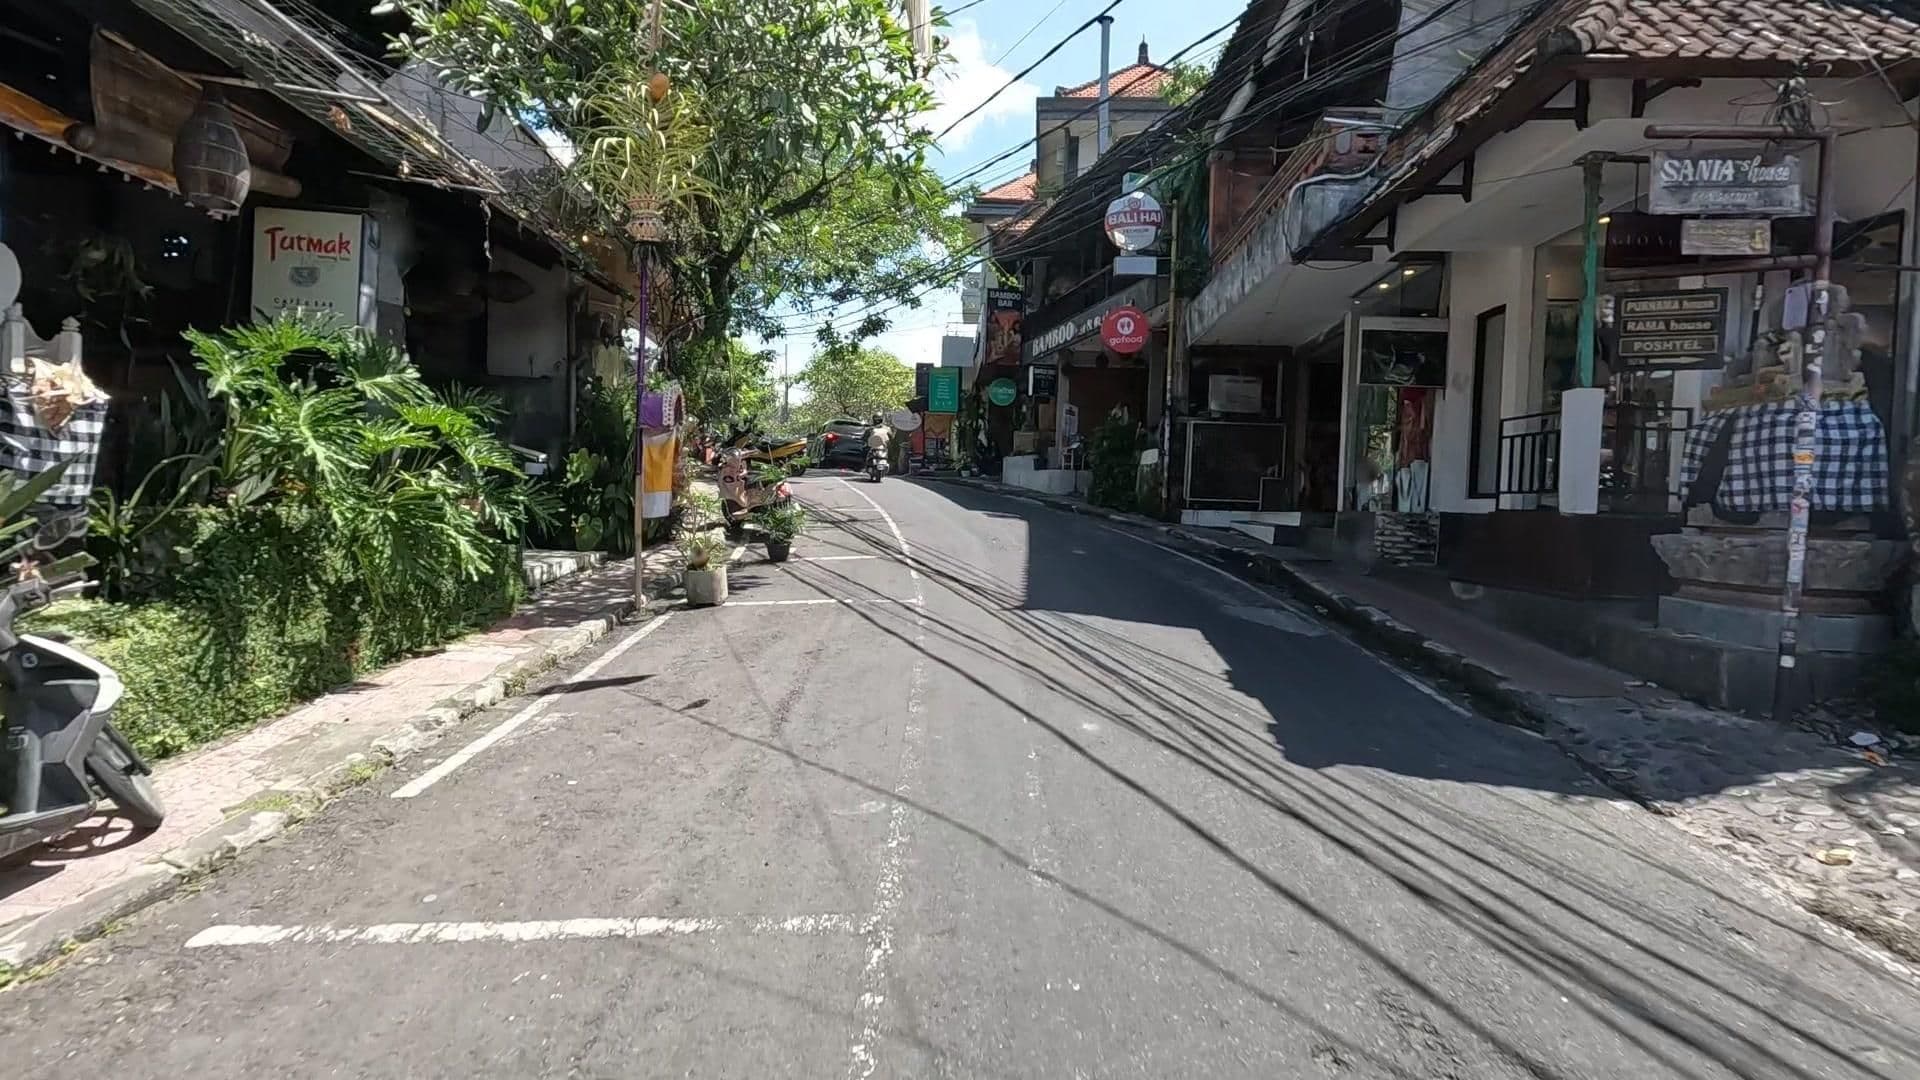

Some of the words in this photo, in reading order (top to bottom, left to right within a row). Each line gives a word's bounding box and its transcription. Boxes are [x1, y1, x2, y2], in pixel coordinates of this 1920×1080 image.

[1108, 212, 1138, 226] BALI
[1140, 211, 1162, 223] HAI
[990, 290, 1022, 300] BAMBOO
[997, 299, 1013, 308] BAR
[1626, 320, 1667, 332] RAMA
[1669, 319, 1712, 331] house
[1032, 321, 1074, 357] BAMBOO
[1109, 335, 1143, 346] gofood
[1633, 340, 1704, 352] POSHTEL
